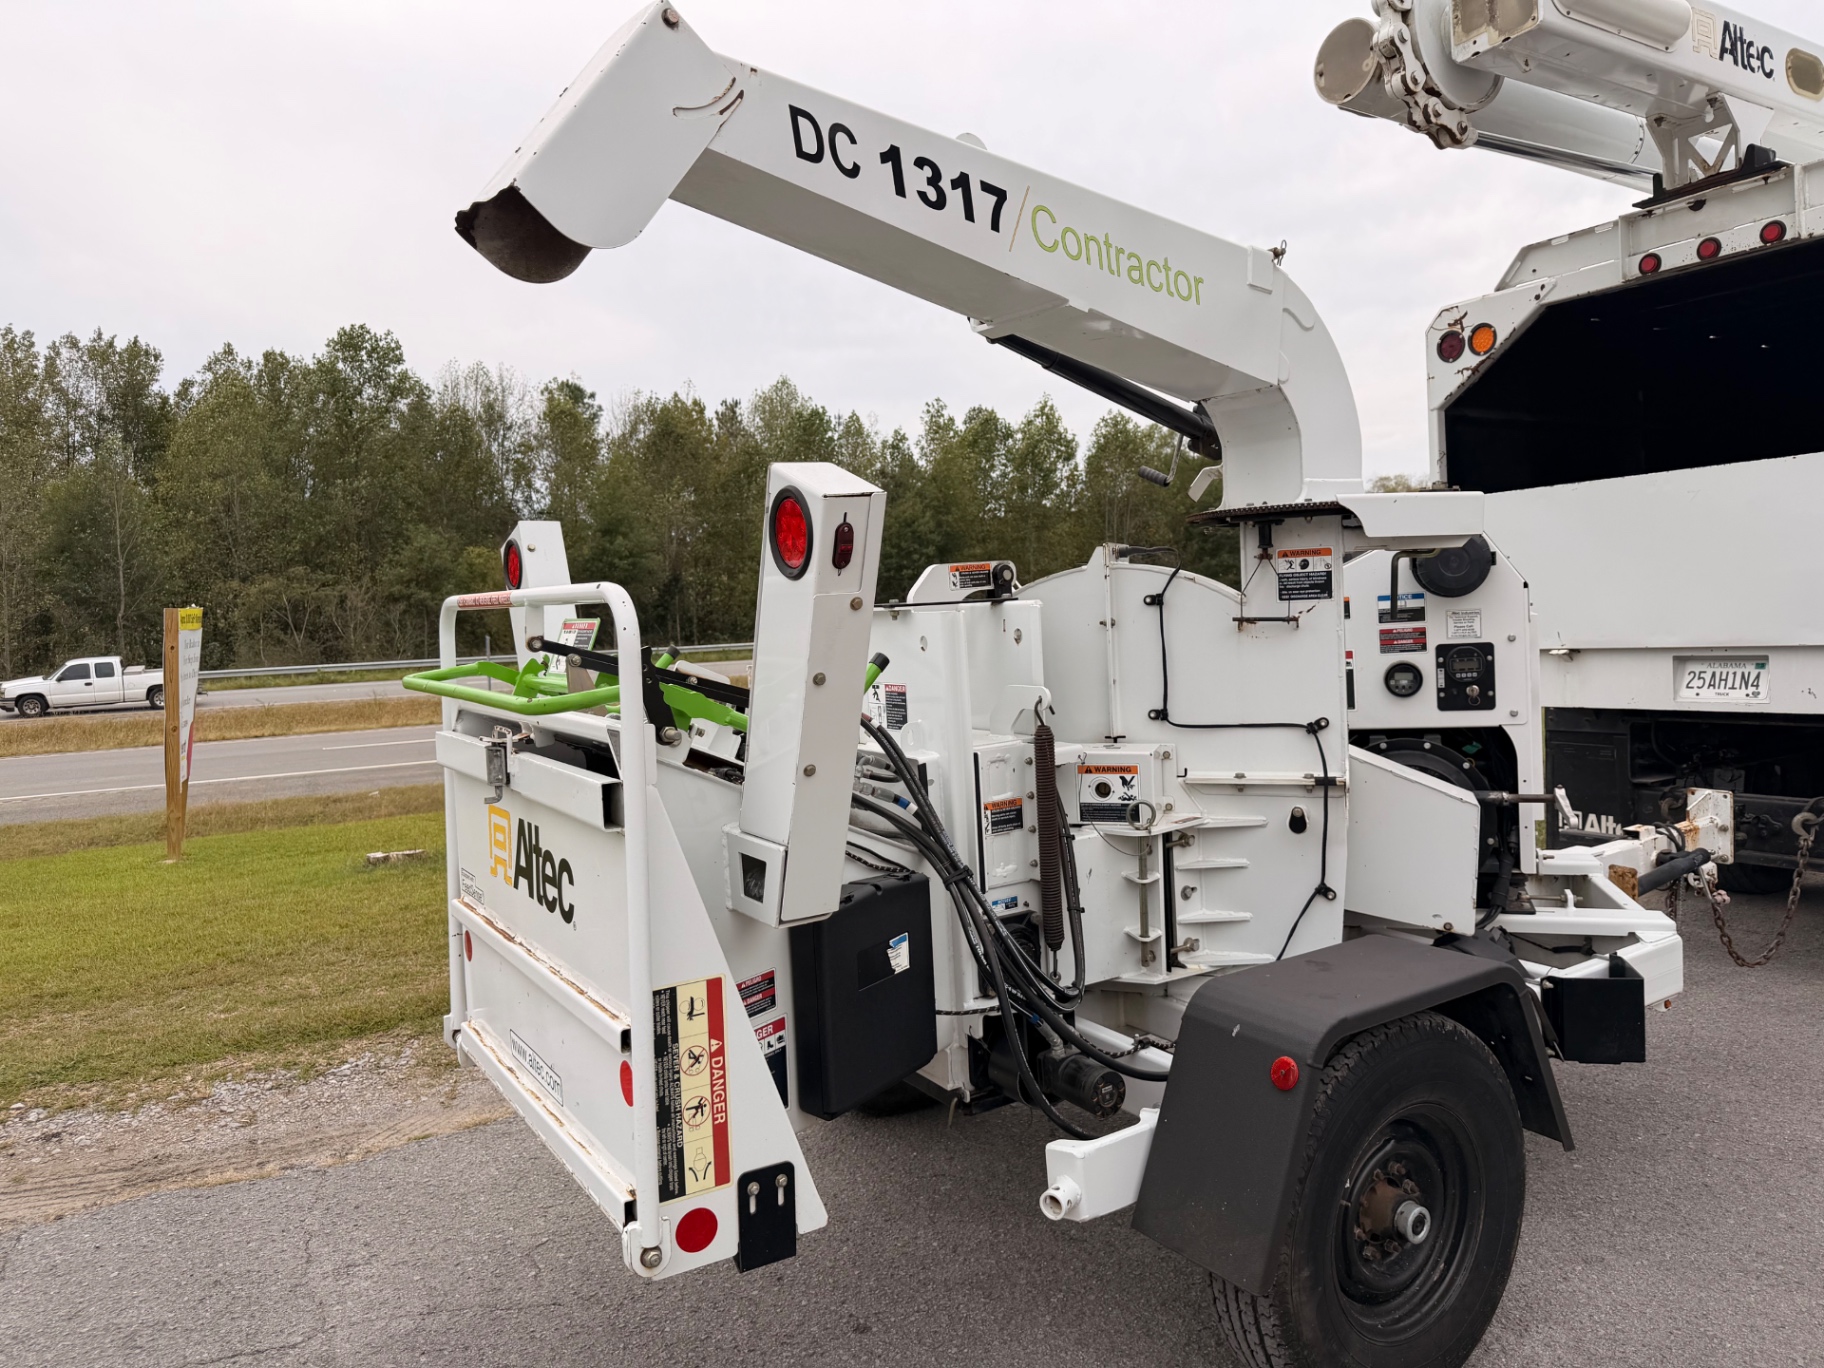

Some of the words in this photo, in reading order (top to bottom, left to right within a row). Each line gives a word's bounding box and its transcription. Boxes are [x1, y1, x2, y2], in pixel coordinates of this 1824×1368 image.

[1719, 20, 1774, 79] Altec
[789, 104, 860, 179] DC
[880, 144, 1007, 233] 1317
[1031, 204, 1204, 305] Contractor
[1686, 671, 1761, 690] 25AH1N4
[992, 800, 1017, 808] WARNING
[514, 818, 574, 924] Altec
[756, 1024, 773, 1039] GER
[712, 1056, 726, 1124] DANGER
